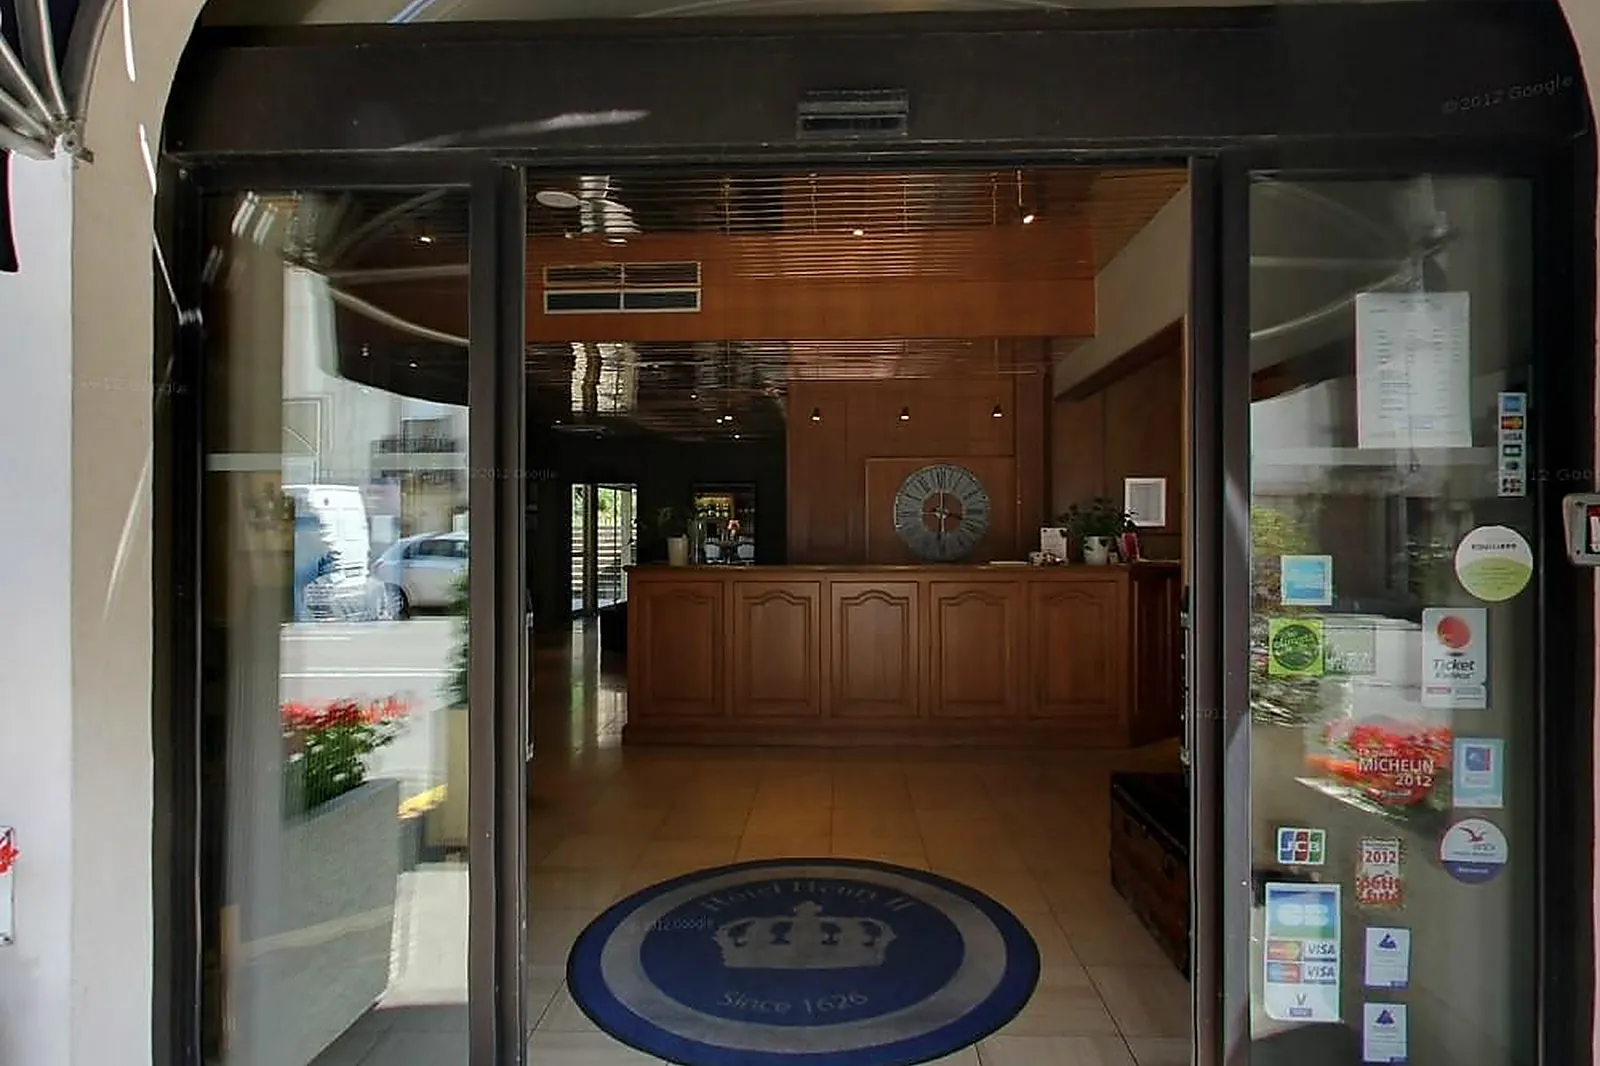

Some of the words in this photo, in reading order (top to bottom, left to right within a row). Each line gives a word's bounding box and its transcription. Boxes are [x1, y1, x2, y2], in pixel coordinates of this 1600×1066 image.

[1433, 658, 1475, 671] Ticket
[1358, 758, 1434, 775] MICHELIN
[1395, 773, 1433, 788] 2012
[1364, 850, 1397, 864] 2012
[1307, 943, 1336, 956] VISA
[1307, 965, 1335, 979] VISA
[716, 990, 792, 1015] Since
[803, 991, 869, 1015] 1626
